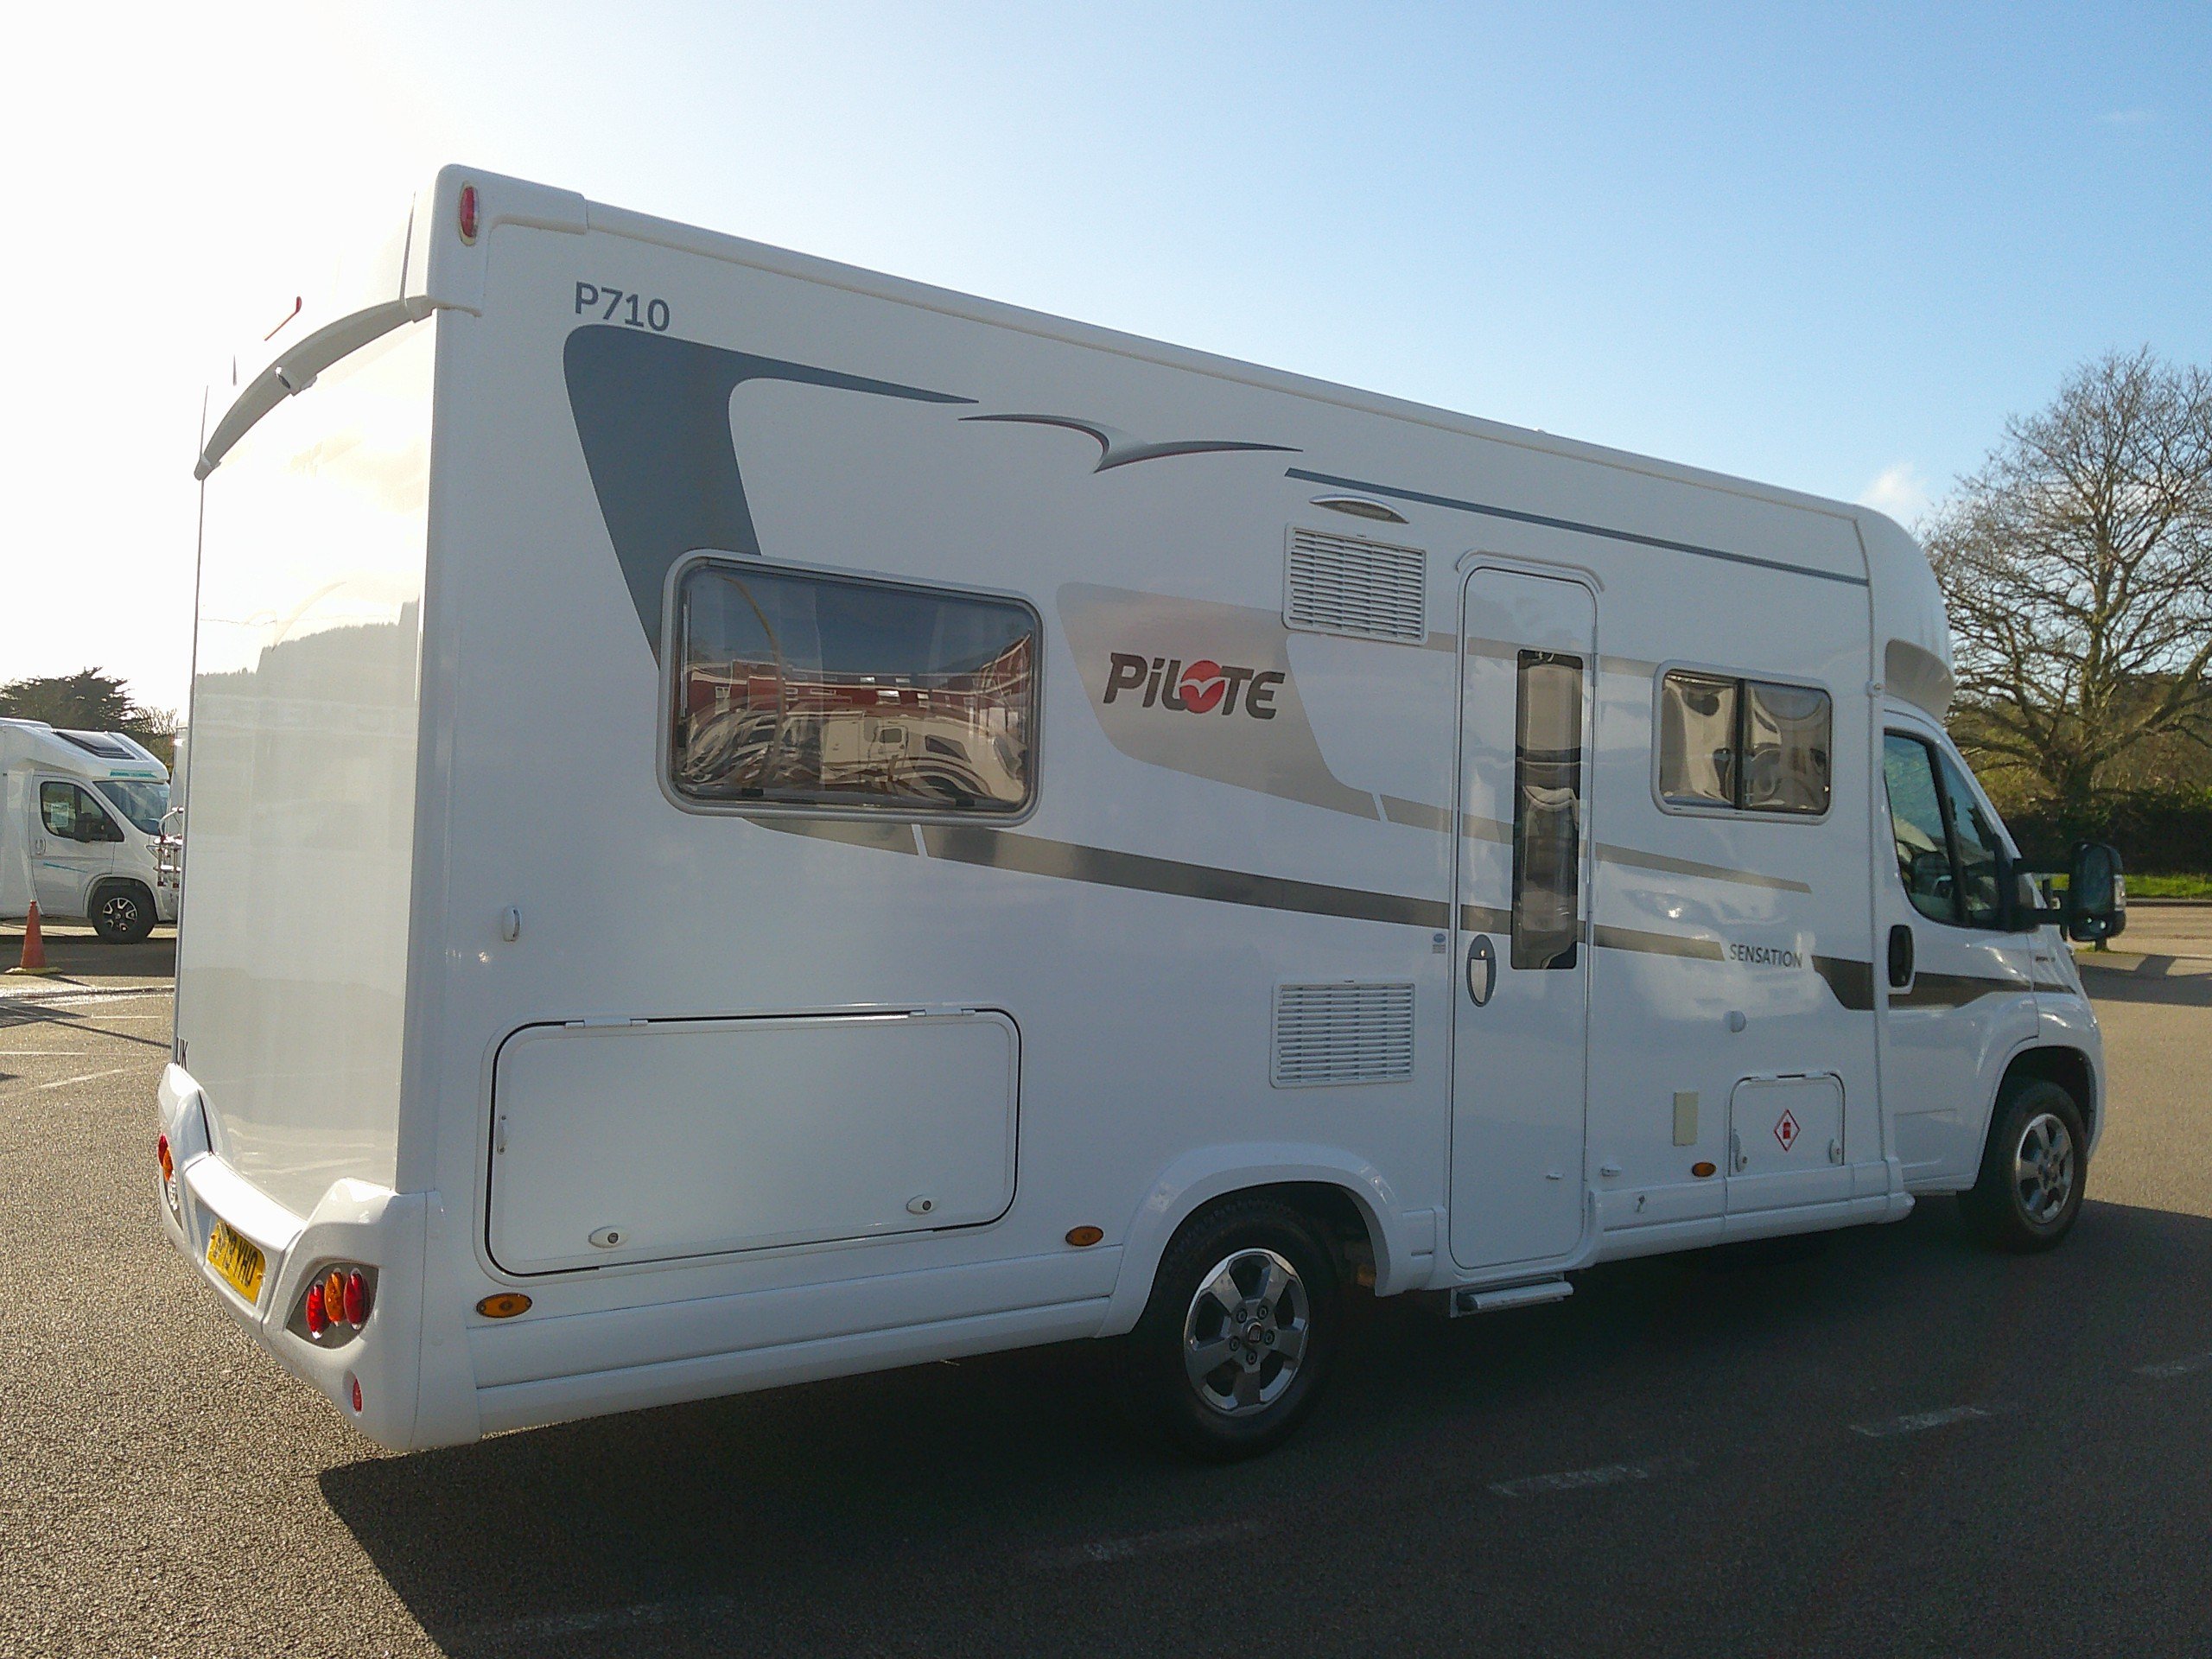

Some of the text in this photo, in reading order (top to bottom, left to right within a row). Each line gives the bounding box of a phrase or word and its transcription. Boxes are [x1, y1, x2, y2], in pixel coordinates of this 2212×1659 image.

[575, 281, 671, 332] P710
[1729, 944, 1802, 969] SENSATION
[175, 1037, 188, 1071] UK
[213, 1225, 238, 1270] 19
